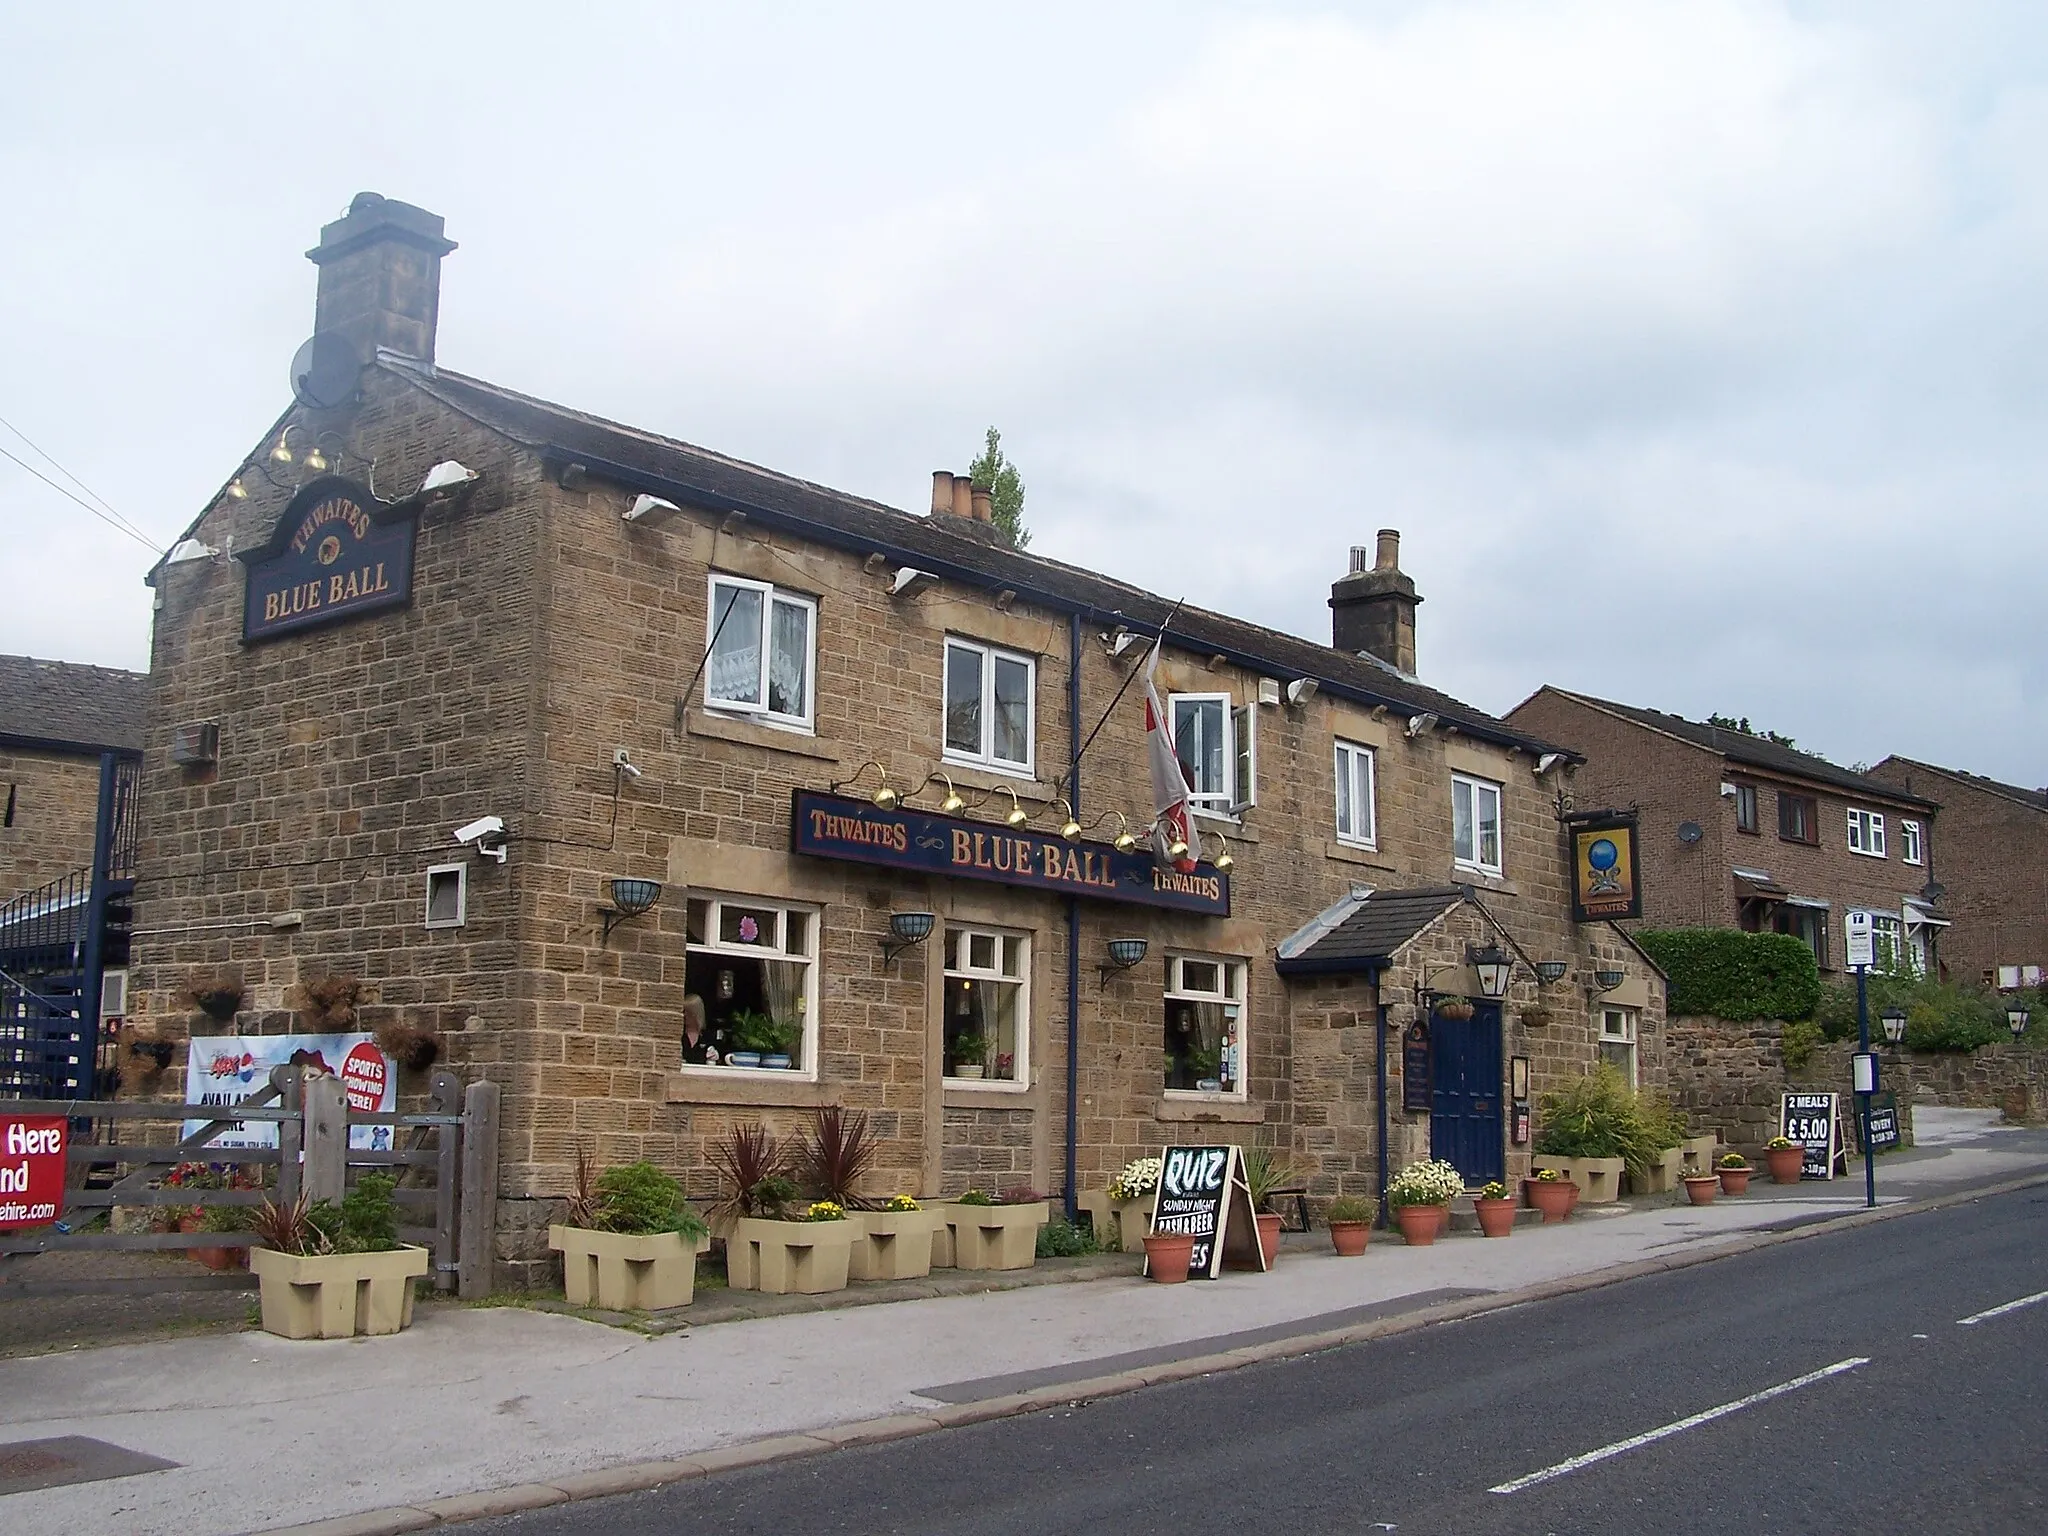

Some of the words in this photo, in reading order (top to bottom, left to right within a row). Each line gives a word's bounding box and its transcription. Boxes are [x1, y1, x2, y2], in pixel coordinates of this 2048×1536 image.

[291, 498, 370, 555] THWAITES
[264, 580, 322, 621] BLUE
[328, 562, 388, 604] BALL
[810, 809, 907, 852] THWAITES
[951, 828, 1033, 875] BLUE
[1042, 844, 1117, 888] BALL
[347, 1057, 384, 1079] SPORTS
[1788, 1096, 1796, 1108] 2
[1797, 1096, 1829, 1108] MEALS
[8, 1123, 61, 1155] Here
[1799, 1118, 1828, 1139] 5.00
[1164, 1149, 1226, 1197] QUIZ
[1163, 1199, 1194, 1212] SUNDAY
